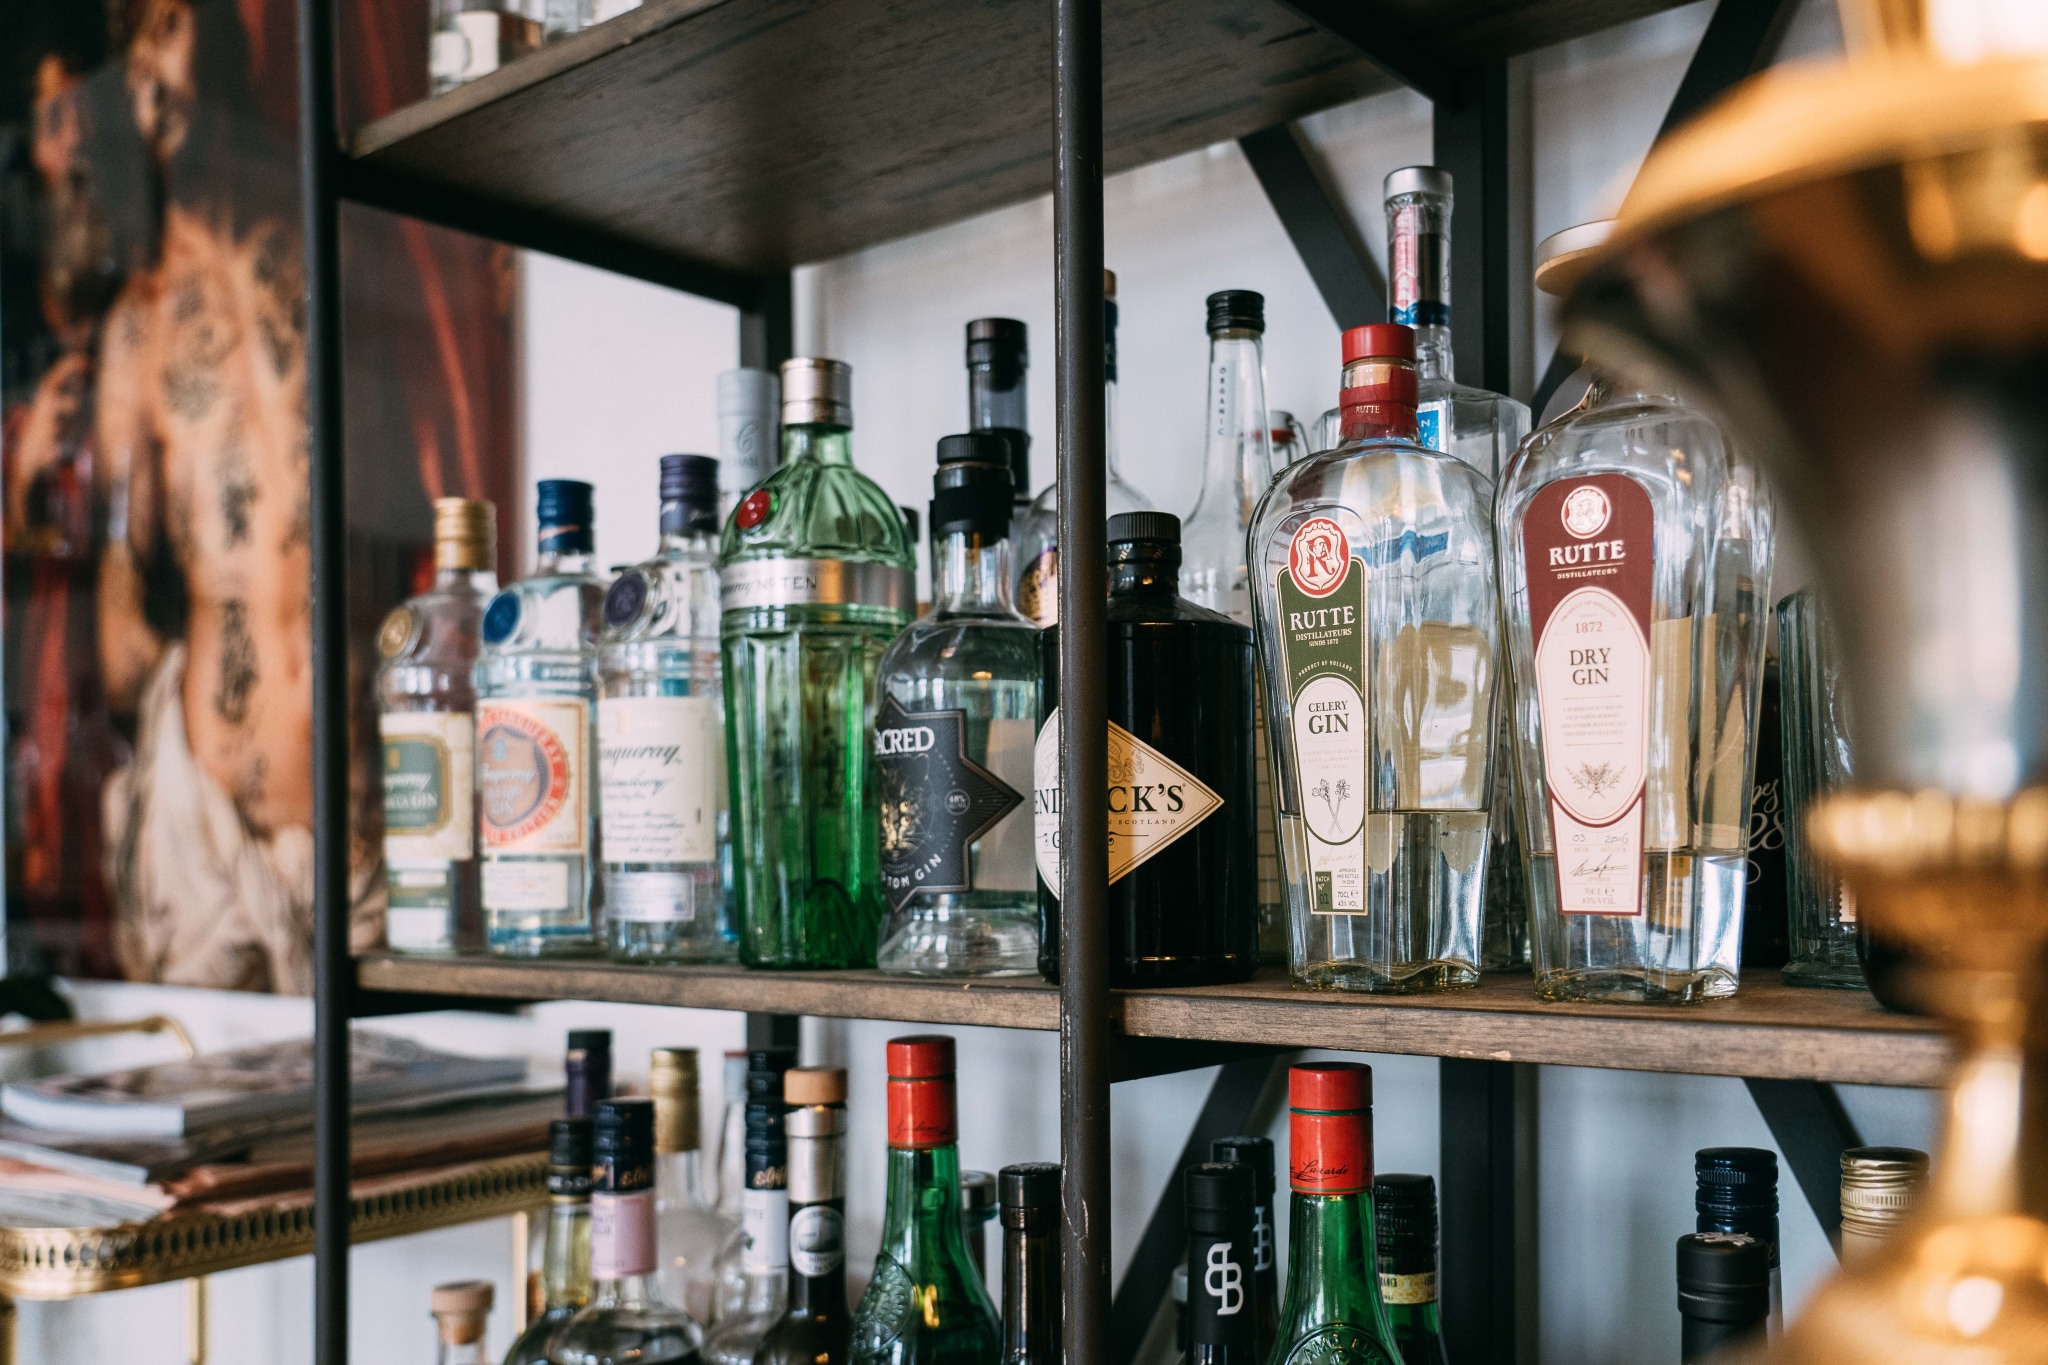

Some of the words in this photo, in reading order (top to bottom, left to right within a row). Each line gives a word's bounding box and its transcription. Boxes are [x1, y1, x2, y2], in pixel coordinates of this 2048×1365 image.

[1218, 366, 1227, 436] ORGANIC
[1355, 404, 1381, 415] RUTTE
[1549, 540, 1627, 566] RUTTE
[1556, 568, 1618, 580] DISTILLATEURS
[782, 575, 818, 591] TEN
[1289, 605, 1356, 631] RUTTE
[1575, 621, 1604, 634] 1872
[1295, 628, 1352, 642] DISTILLATEURS
[1308, 639, 1327, 647] SINDS
[1327, 638, 1339, 646] 1872
[1569, 647, 1612, 666] DRY
[1298, 661, 1321, 679] PRODUCT
[1329, 660, 1353, 673] HOLLAND
[1572, 668, 1610, 686] GIN
[1308, 700, 1348, 713] CELERY
[1308, 713, 1350, 735] GIN
[1118, 818, 1176, 826] SCOTLAND
[1572, 833, 1586, 842] 03
[1604, 832, 1629, 844] 2016
[914, 853, 943, 881] GIN
[886, 876, 910, 890] TOM
[1319, 893, 1330, 905] 01
